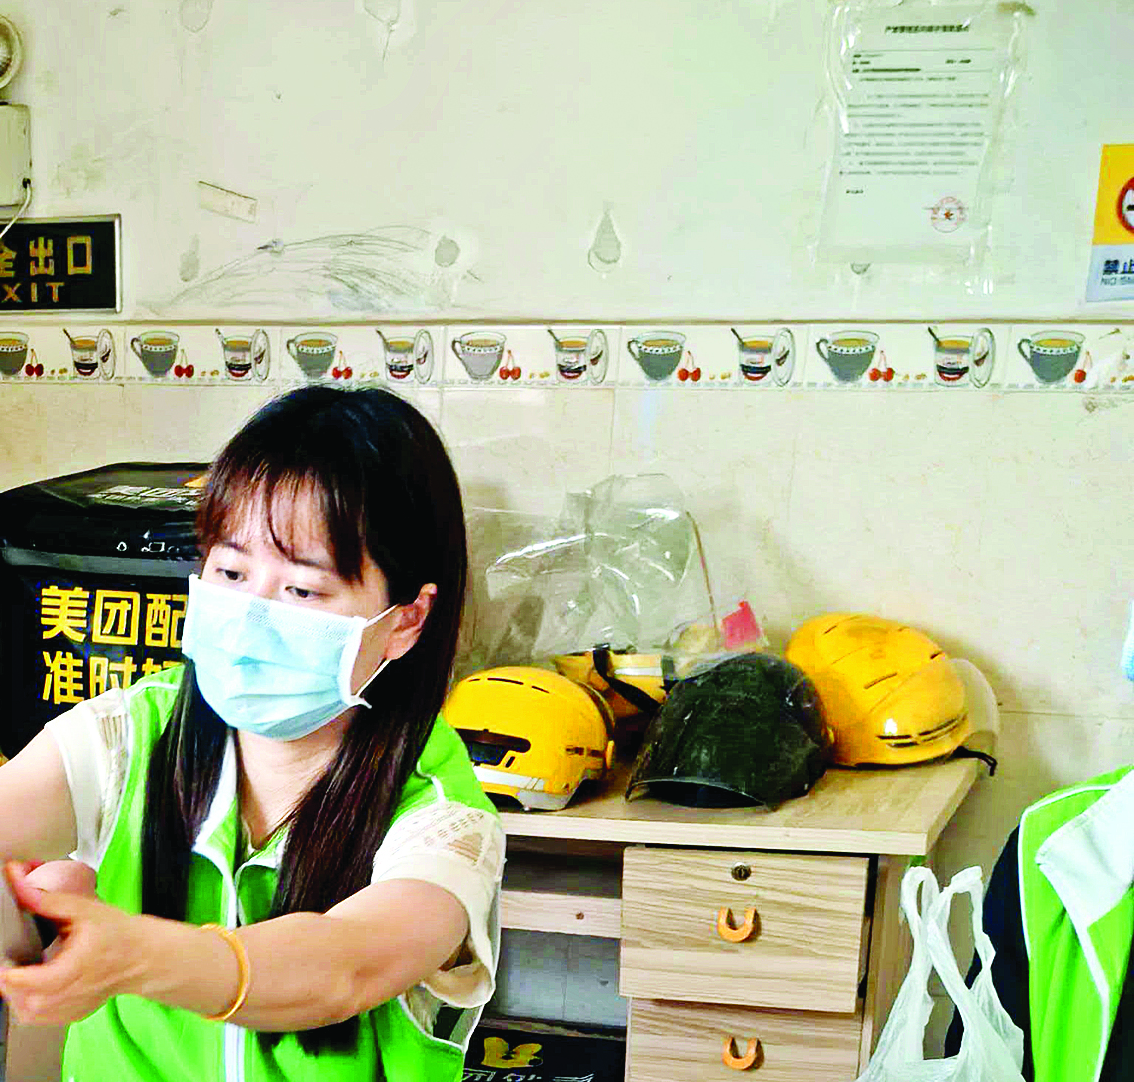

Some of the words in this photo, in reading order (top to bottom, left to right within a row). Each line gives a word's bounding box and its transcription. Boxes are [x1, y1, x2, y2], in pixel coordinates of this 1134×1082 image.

[41, 585, 189, 648] 美团配
[42, 650, 183, 704] 准时
